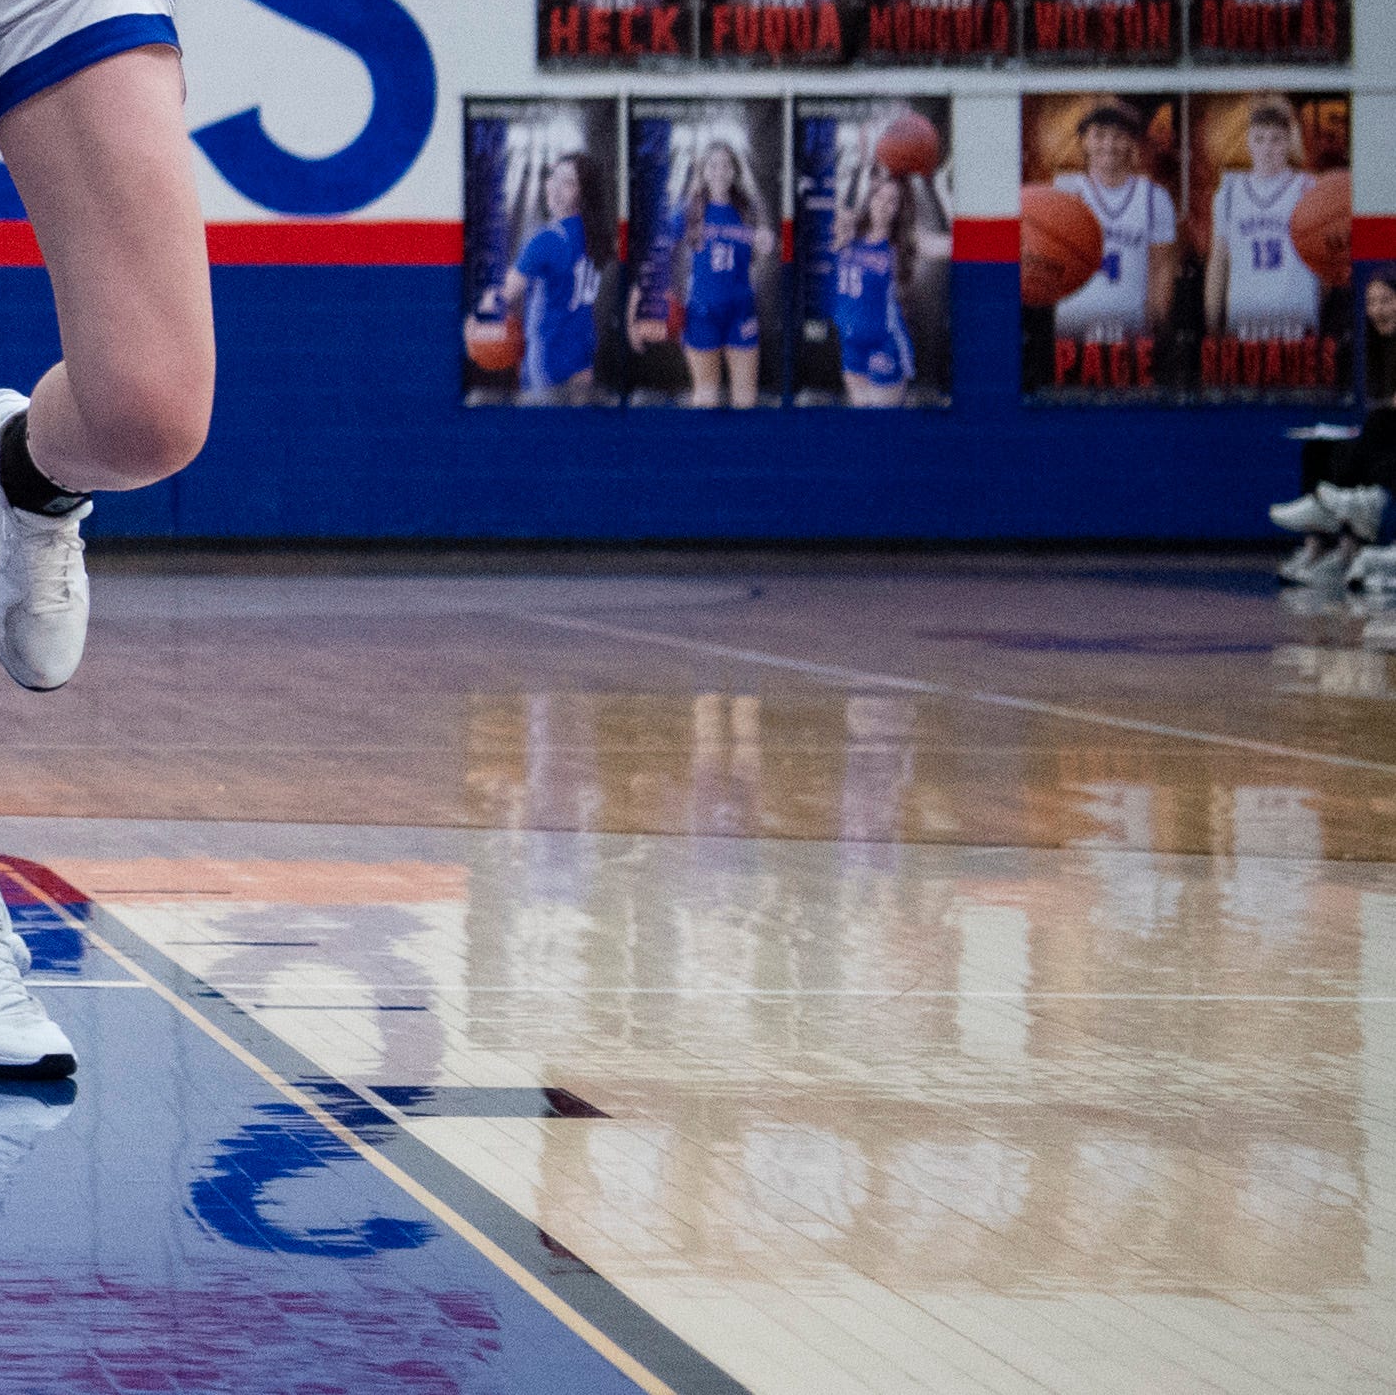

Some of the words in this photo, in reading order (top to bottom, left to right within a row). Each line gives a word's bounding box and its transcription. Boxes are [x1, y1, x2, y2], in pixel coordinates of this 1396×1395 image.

[549, 5, 679, 56] HECK
[711, 1, 843, 59] FUQUA
[1035, 0, 1172, 52] WILSON
[1054, 336, 1154, 388] PAGE
